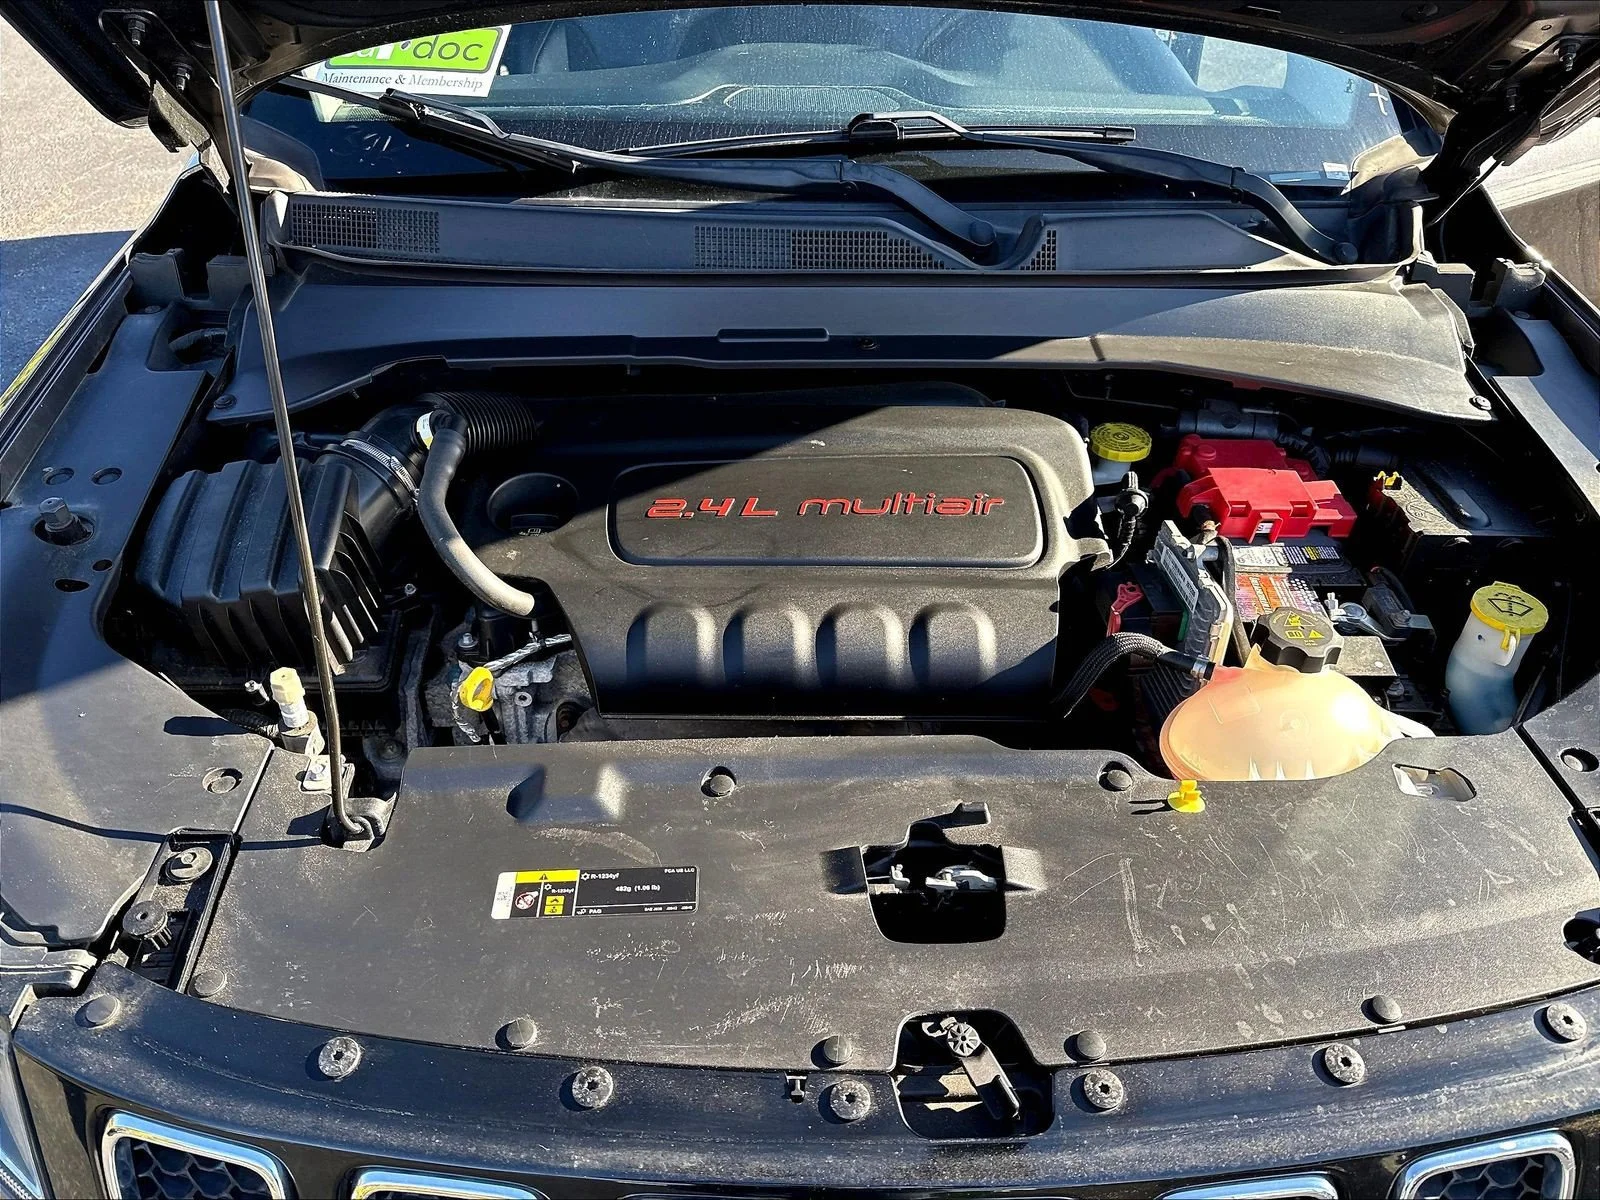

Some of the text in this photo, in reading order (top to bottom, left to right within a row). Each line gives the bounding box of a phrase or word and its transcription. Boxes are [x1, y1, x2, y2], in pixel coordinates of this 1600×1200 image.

[322, 72, 484, 92] Maintenance & Membership
[798, 491, 1005, 517] multiair
[590, 872, 620, 880] R-1234yf
